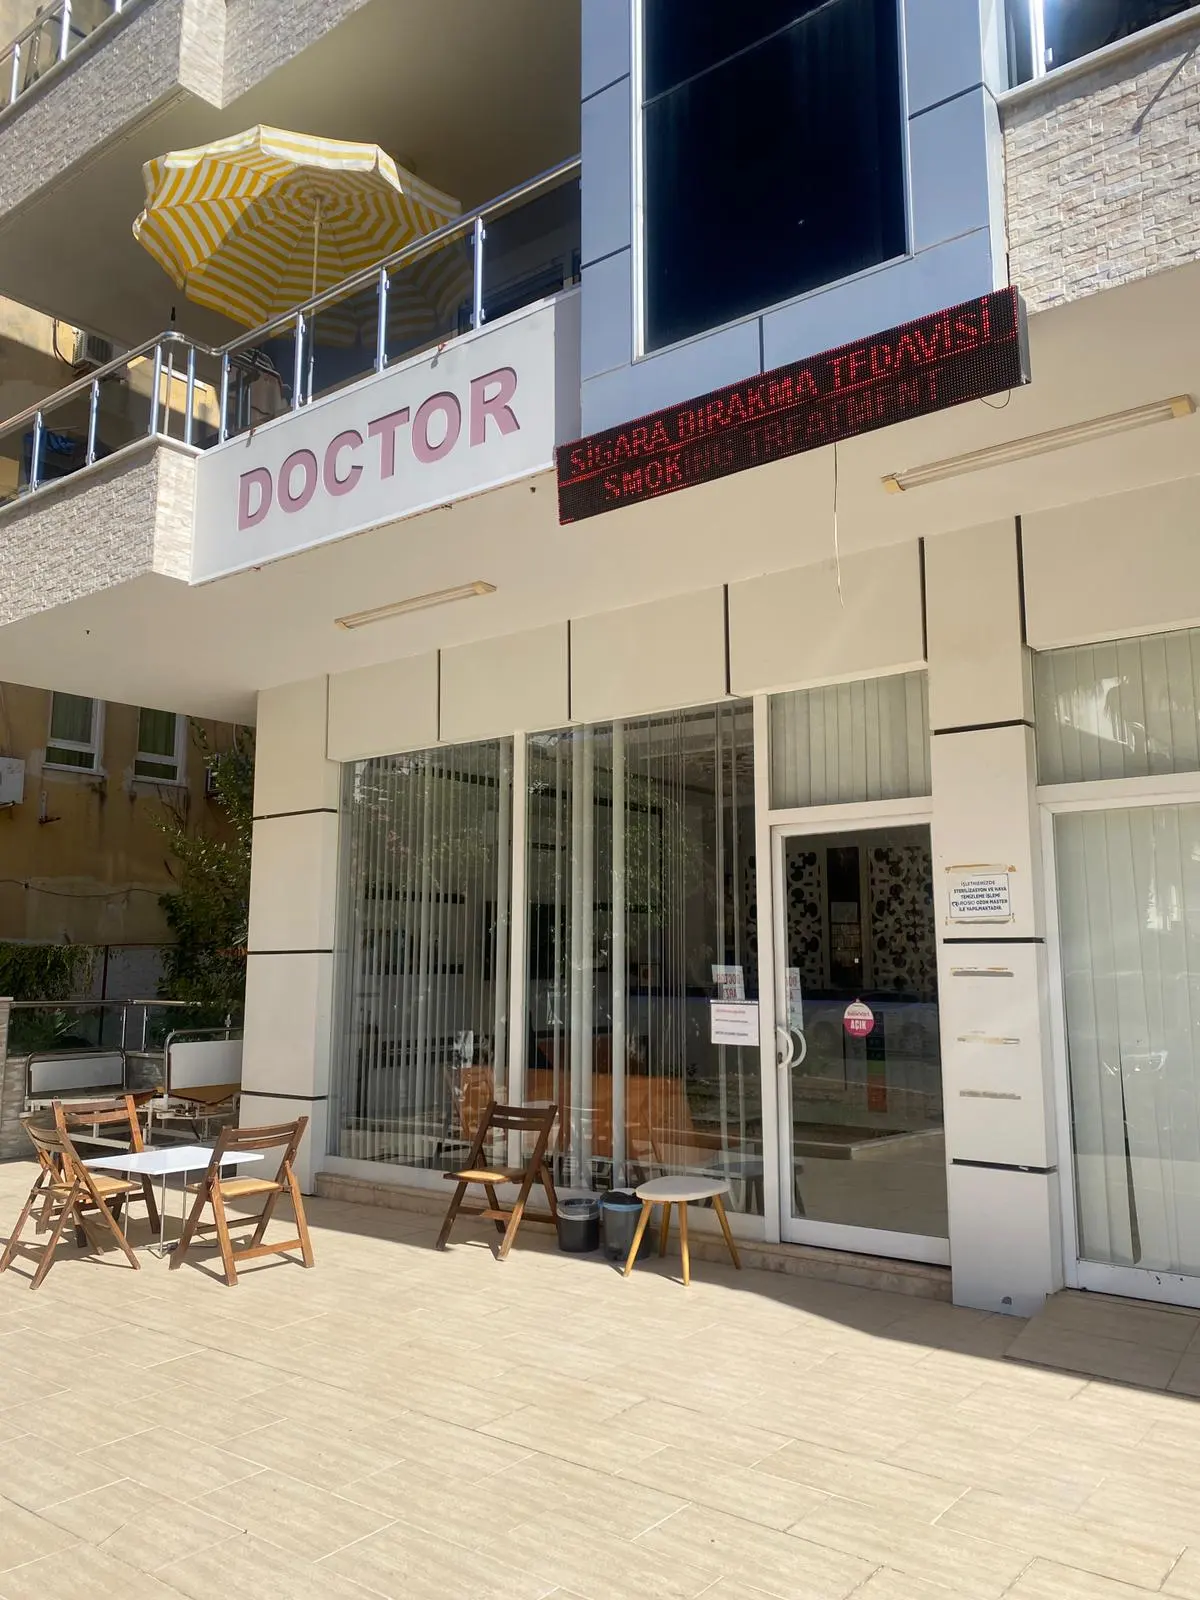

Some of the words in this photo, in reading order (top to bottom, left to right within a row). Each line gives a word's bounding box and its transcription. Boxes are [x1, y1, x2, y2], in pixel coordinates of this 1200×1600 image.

[238, 366, 520, 531] DOCTOR
[570, 421, 670, 474] SİGARA
[677, 368, 818, 438] BIRAKMA
[826, 297, 991, 393] TEDAVİSİ
[603, 438, 734, 500] SMOKING
[745, 367, 944, 457] TREATMENT
[850, 1019, 867, 1031] AÇIK
